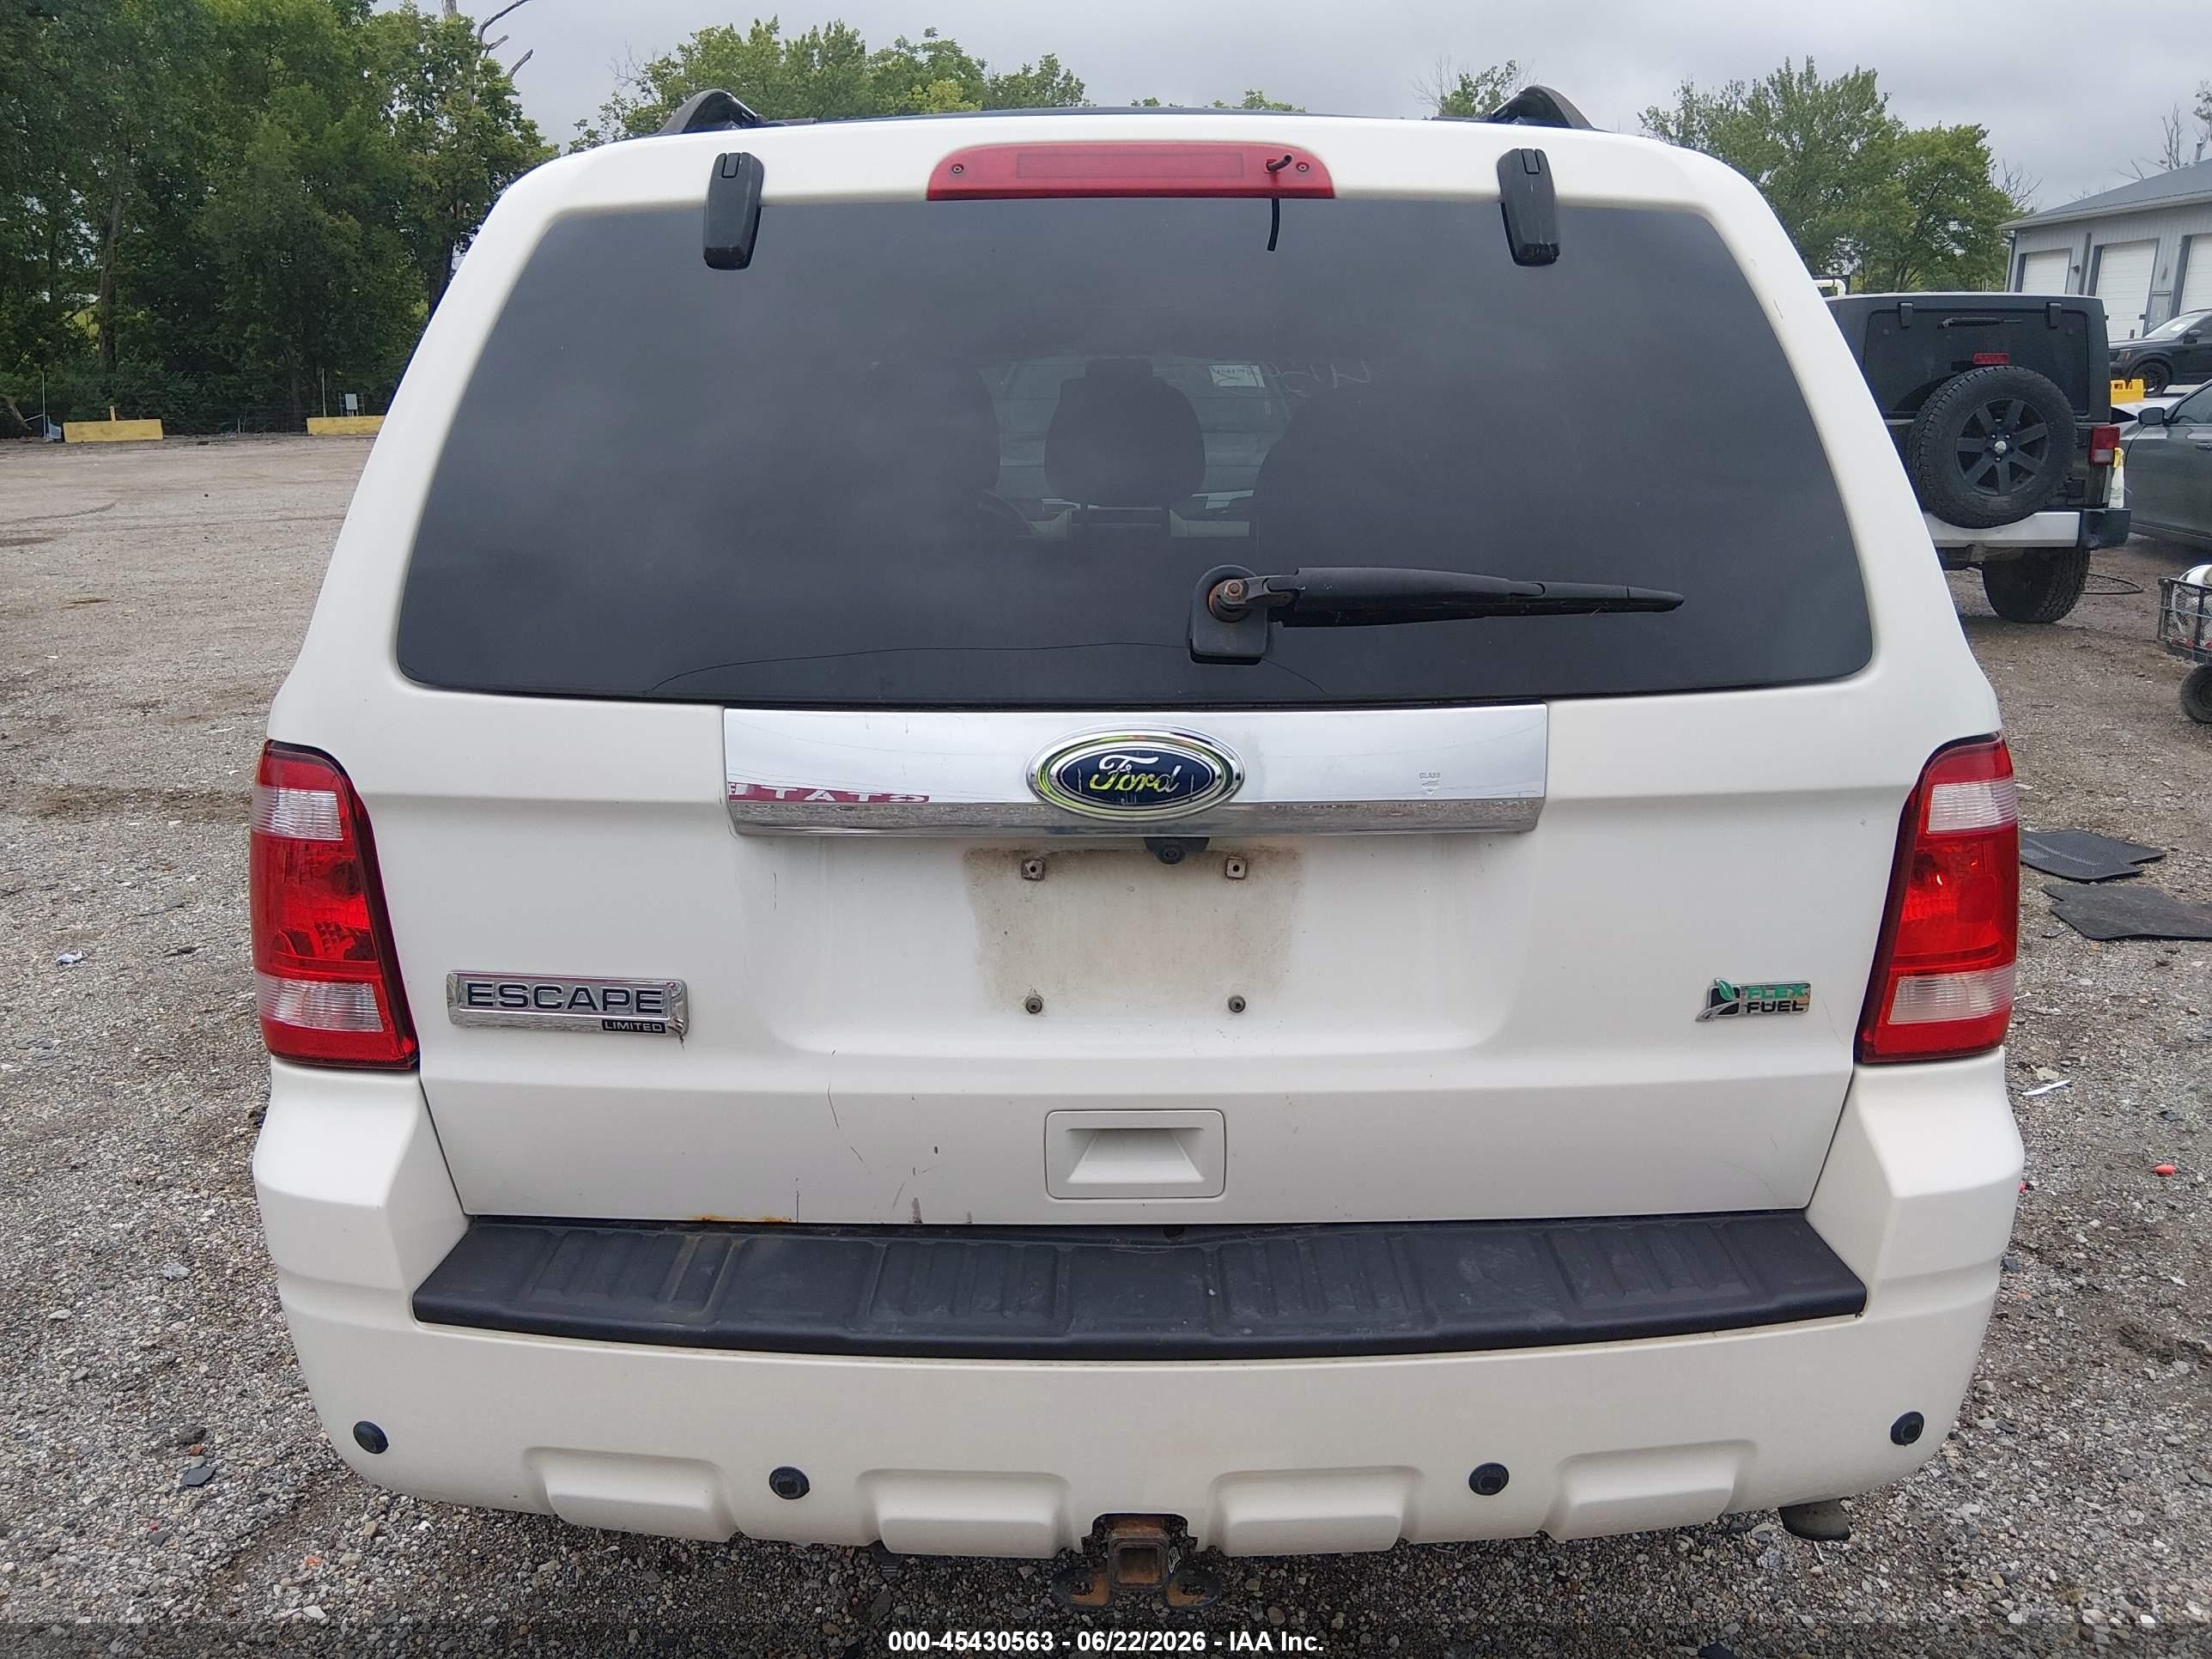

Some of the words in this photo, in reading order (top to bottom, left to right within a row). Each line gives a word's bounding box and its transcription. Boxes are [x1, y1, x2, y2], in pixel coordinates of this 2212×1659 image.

[1089, 754, 1182, 793] Ford
[465, 981, 665, 1014] ESCAPE
[1746, 983, 1808, 1000] FLEX
[1746, 1000, 1804, 1014] FUEL
[604, 1019, 664, 1032] LIMITED
